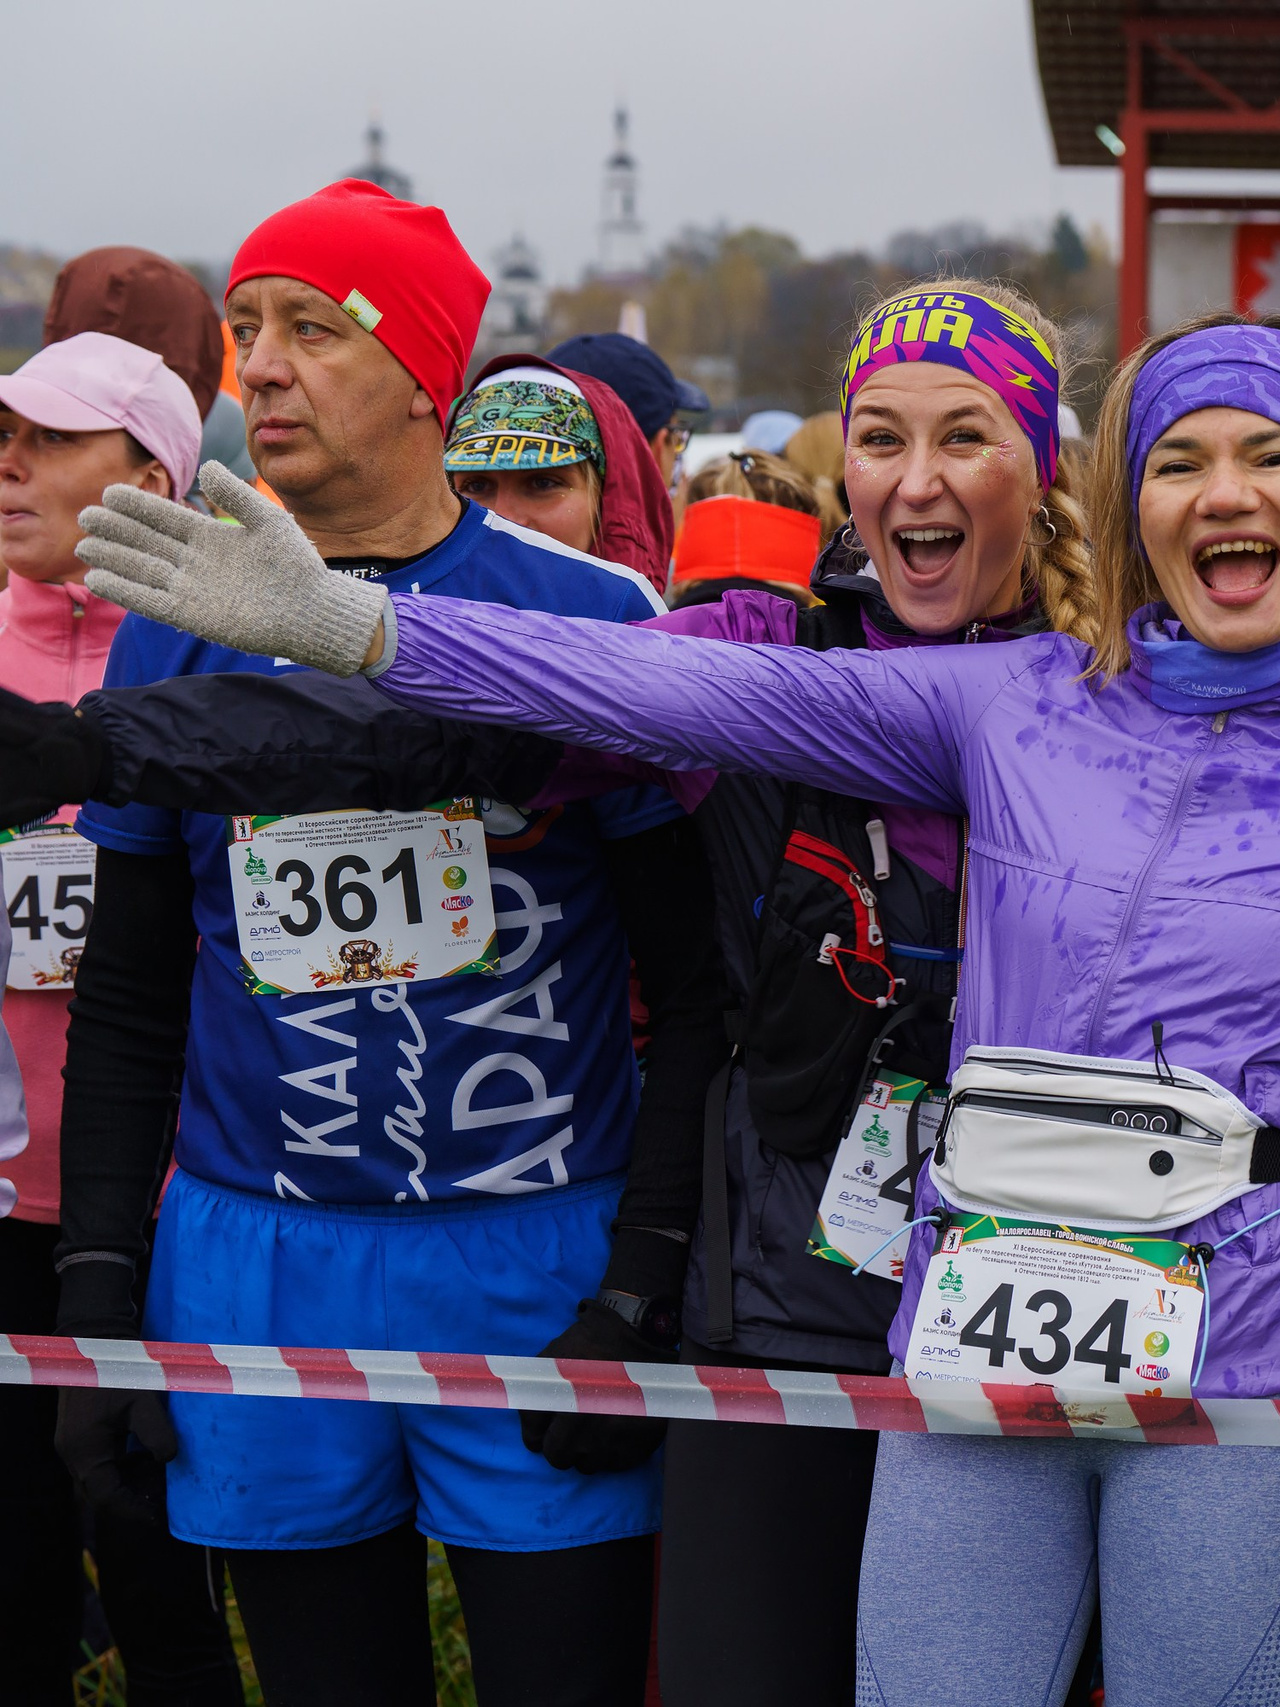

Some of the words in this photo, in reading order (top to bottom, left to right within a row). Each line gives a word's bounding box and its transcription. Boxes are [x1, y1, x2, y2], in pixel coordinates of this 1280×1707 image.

[1192, 683, 1247, 695] КАЛУЖСКИЙ
[305, 819, 349, 827] Всероссийские
[350, 814, 392, 823] соревнования
[281, 828, 314, 836] пересеченной
[309, 839, 347, 847] Отечественной
[275, 847, 423, 937] 361
[8, 874, 95, 940] 45
[265, 948, 301, 956] МЕТРОСТРОЙ
[444, 938, 482, 948] FLORENTIKA
[443, 867, 574, 1195] АРАФ
[847, 1218, 893, 1236] МЕТРОСТРОЙ
[997, 1228, 1051, 1237] «МАЛОЯРОСЛАВЕЦ
[1055, 1230, 1074, 1240] ГОРОД
[1075, 1233, 1108, 1247] ВОИНСКОЙ
[1107, 1240, 1134, 1253] СЛАВЫ»
[991, 1250, 1028, 1258] пересеченной
[1029, 1255, 1058, 1263] местности
[1105, 1264, 1132, 1273] Дорогами
[1020, 1244, 1067, 1257] Всероссийские
[1068, 1252, 1111, 1262] соревнования
[982, 1256, 1017, 1265] посвященные
[1057, 1266, 1110, 1278] Малоярославецкого
[1112, 1274, 1139, 1282] сражения
[1019, 1268, 1059, 1278] Отечественной
[1078, 1275, 1089, 1283] 1812
[939, 1280, 963, 1289] bionova
[959, 1283, 1132, 1384] 434
